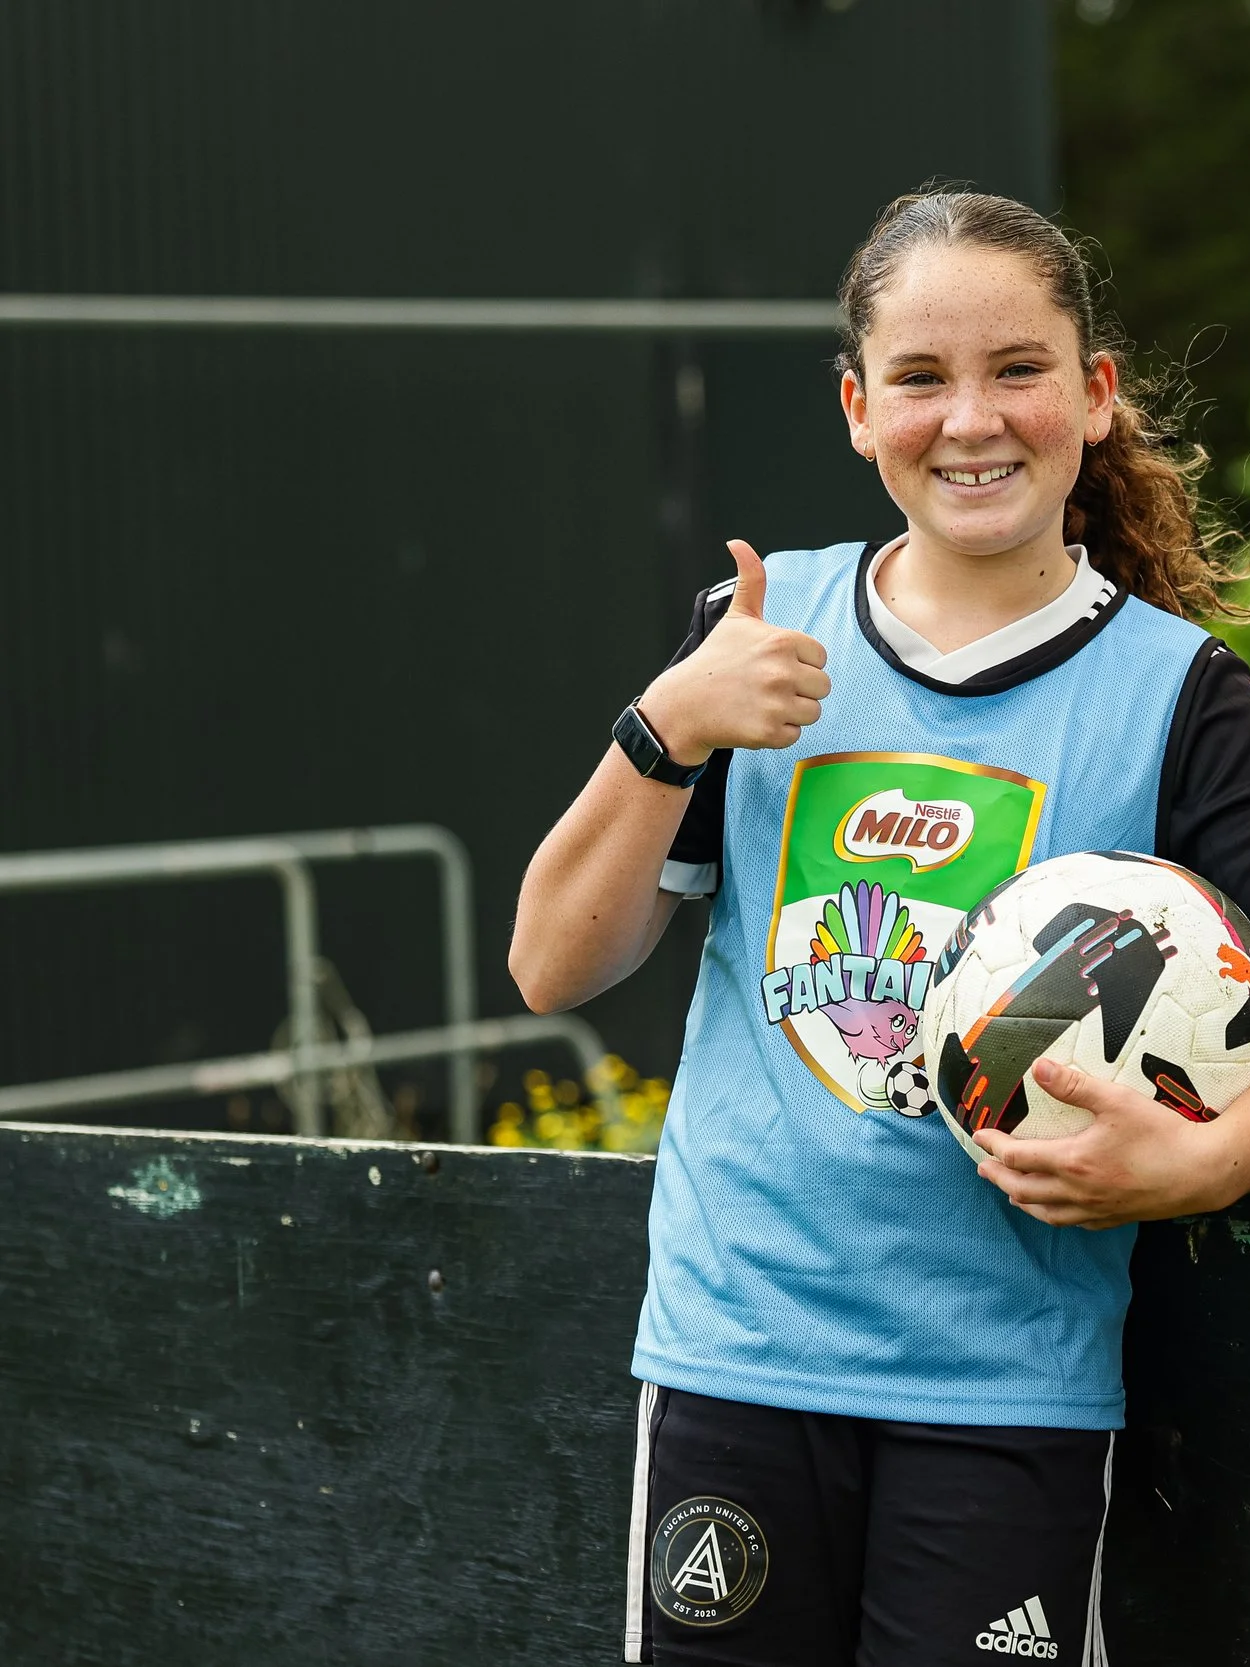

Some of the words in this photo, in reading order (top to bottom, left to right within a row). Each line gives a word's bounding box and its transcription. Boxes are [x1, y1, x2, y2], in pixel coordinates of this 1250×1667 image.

[852, 809, 959, 851] MILO
[761, 952, 934, 1025] FANTAI
[663, 1505, 710, 1538] AUCKLAND
[715, 1506, 749, 1532] UNITED
[673, 1601, 691, 1615] EST
[694, 1609, 717, 1617] 2020
[975, 1631, 1058, 1659] adidas
